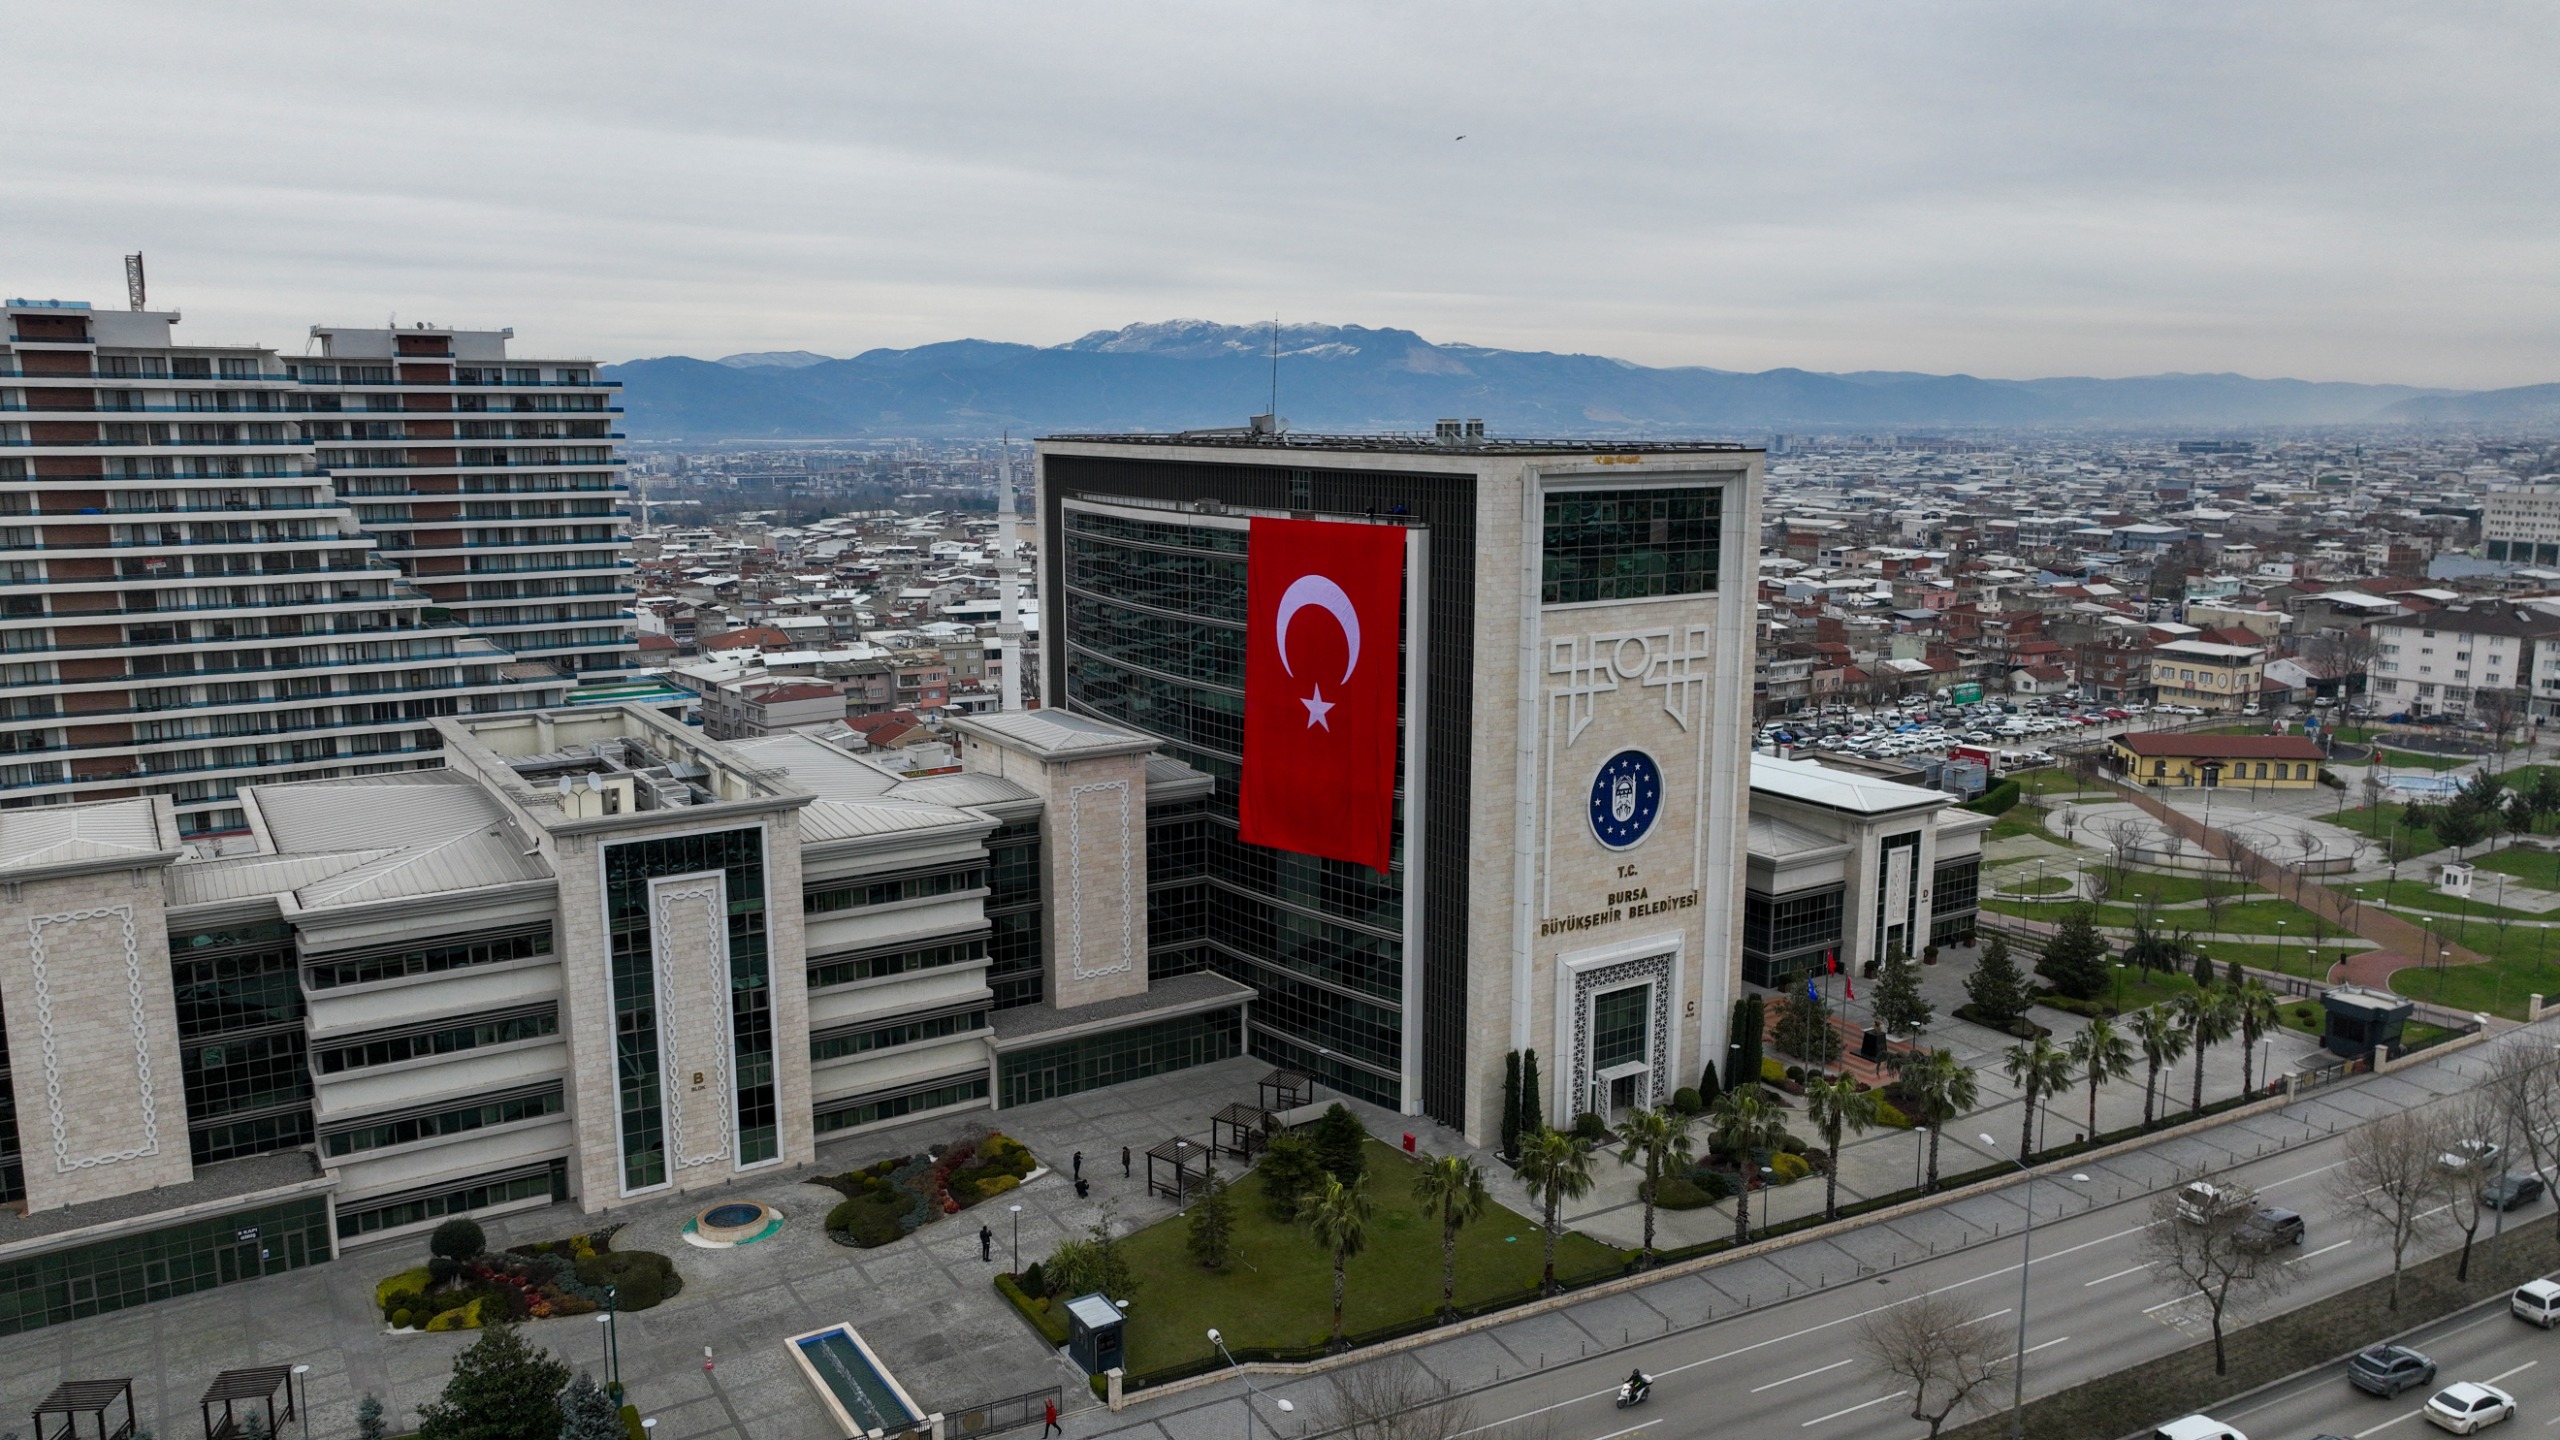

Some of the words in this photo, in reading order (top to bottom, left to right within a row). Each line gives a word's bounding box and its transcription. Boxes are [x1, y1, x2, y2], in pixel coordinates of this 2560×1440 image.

[1617, 864, 1638, 878] T.C.
[1608, 887, 1648, 906] BURSA
[1923, 889, 1929, 898] D
[1541, 907, 1621, 937] BÜYÜKŞEHİR
[1629, 890, 1698, 919] BELEDİYESİ
[1687, 1001, 1694, 1012] C
[693, 1072, 704, 1084] B
